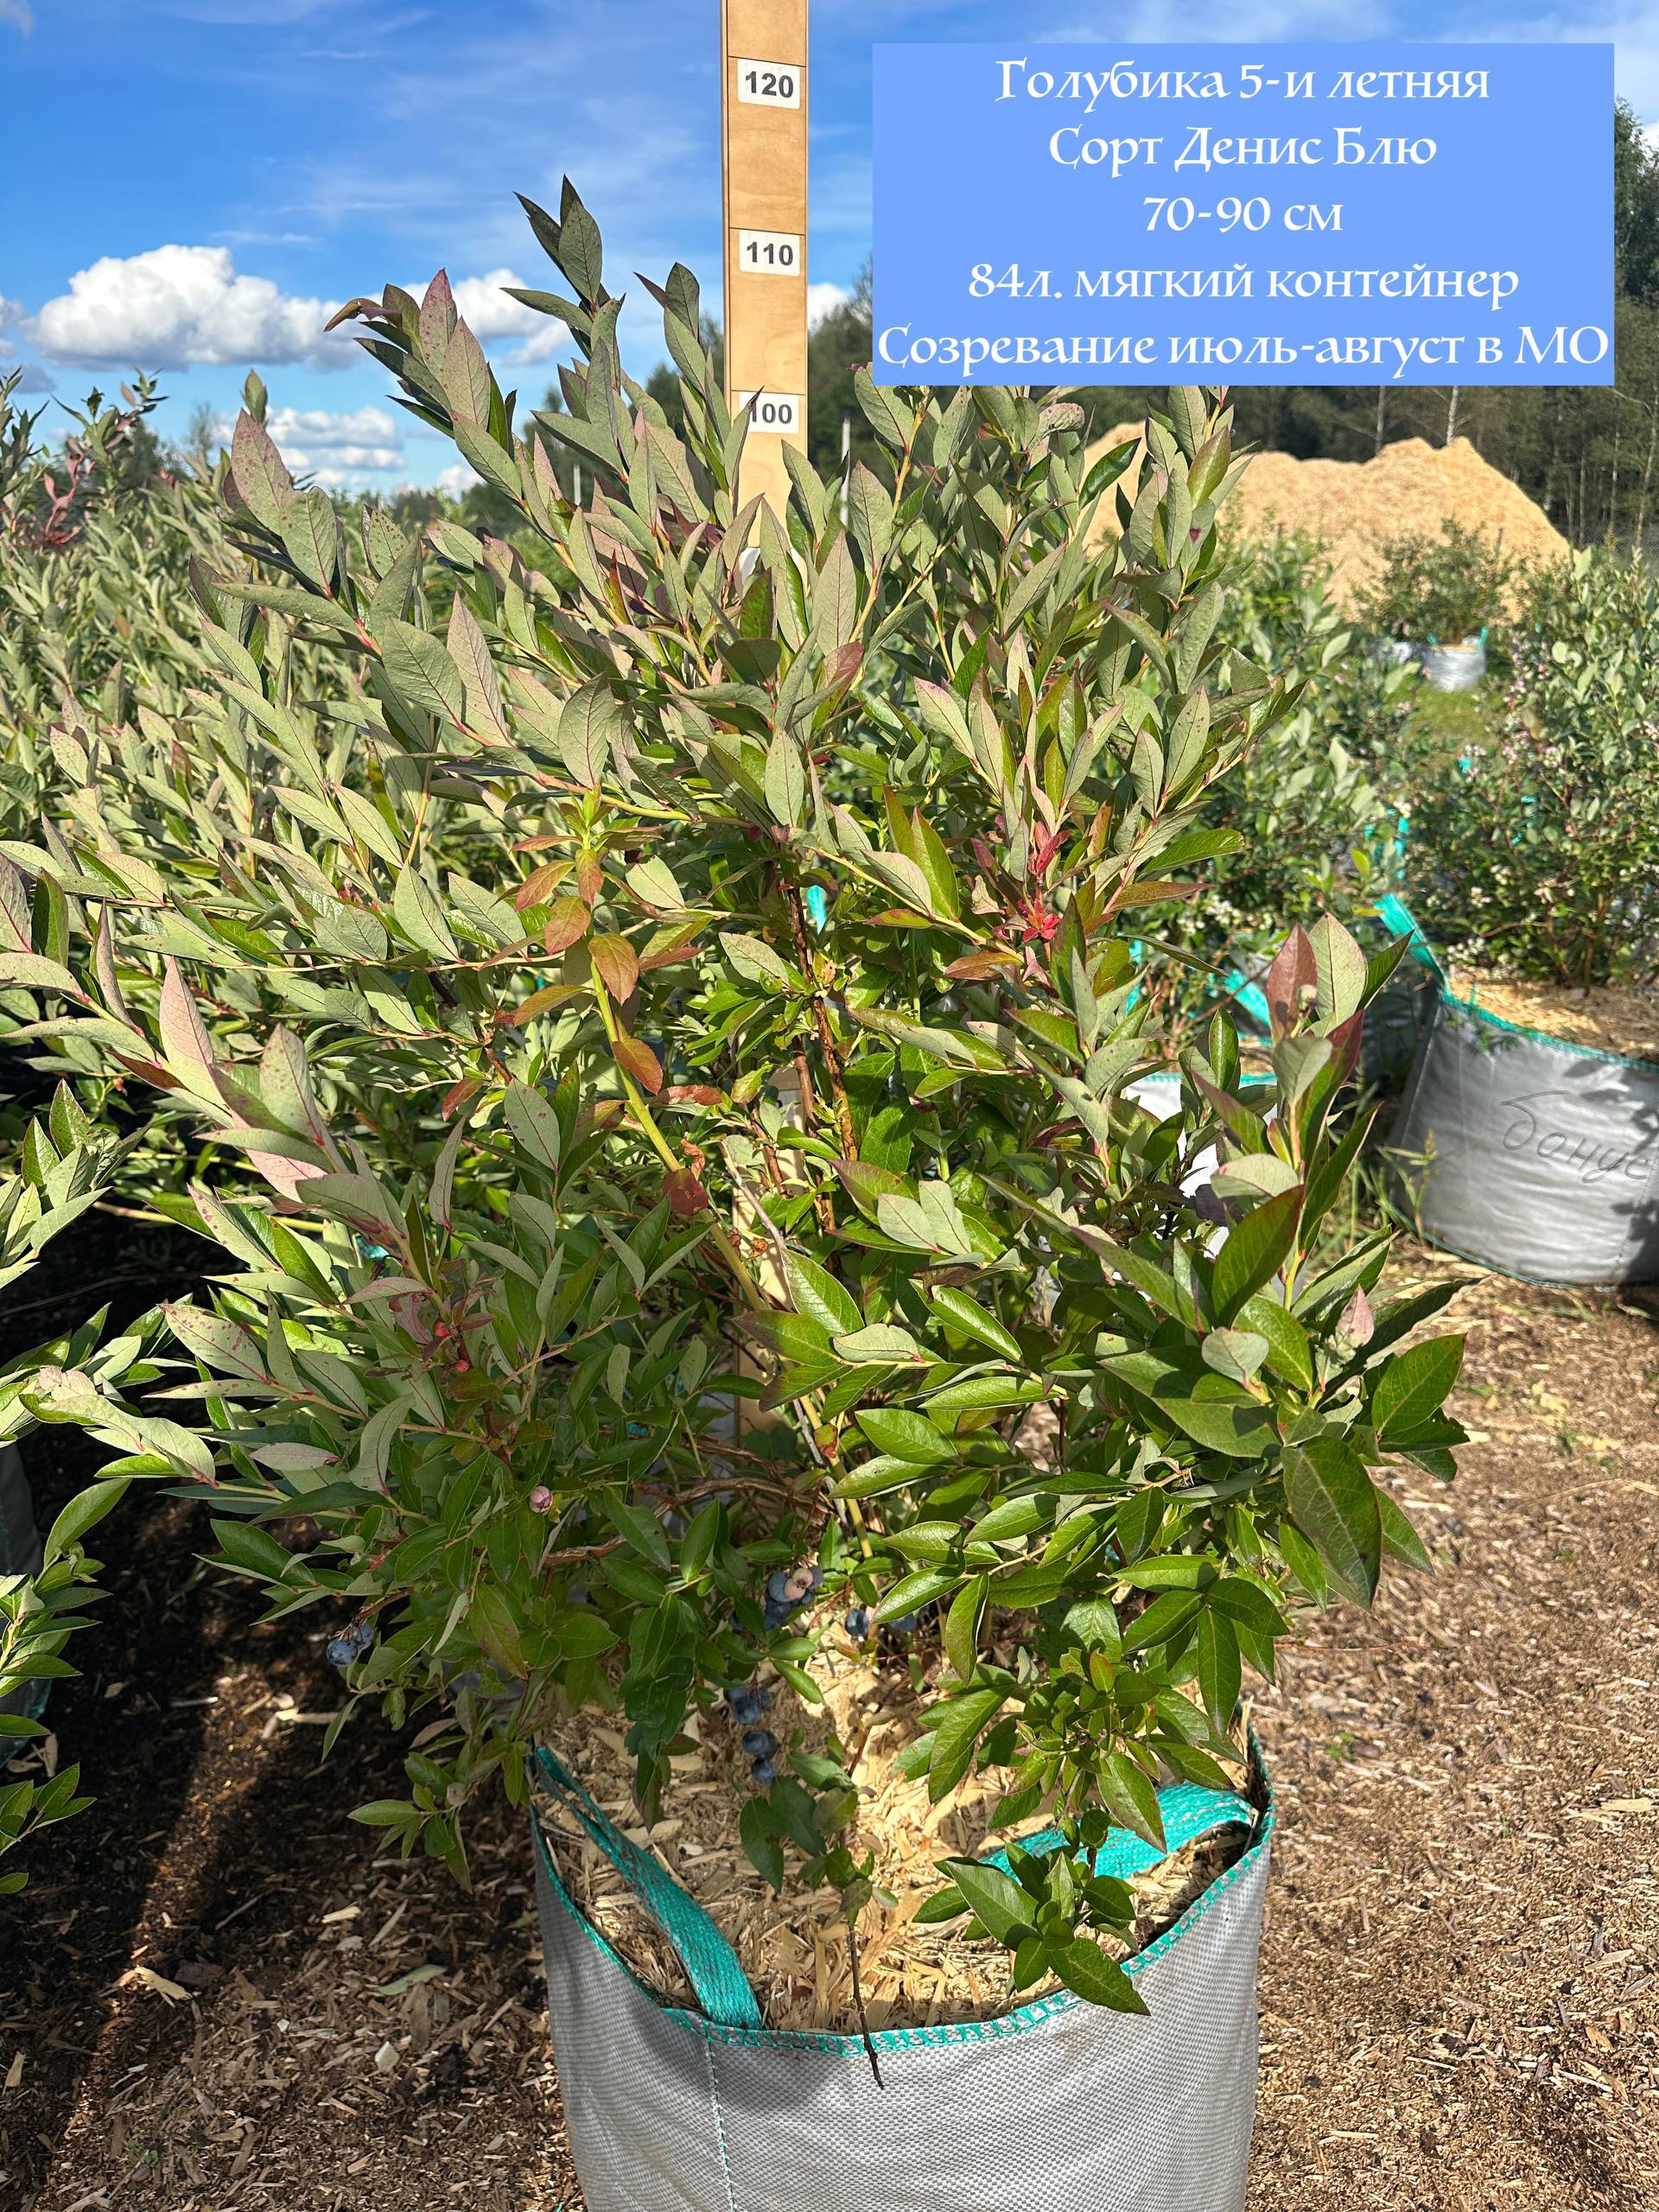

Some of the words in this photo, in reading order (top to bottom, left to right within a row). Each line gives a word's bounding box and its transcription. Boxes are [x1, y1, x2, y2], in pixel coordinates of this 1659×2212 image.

[745, 70, 794, 99] 120
[746, 241, 794, 267] 110
[749, 401, 793, 425] 100
